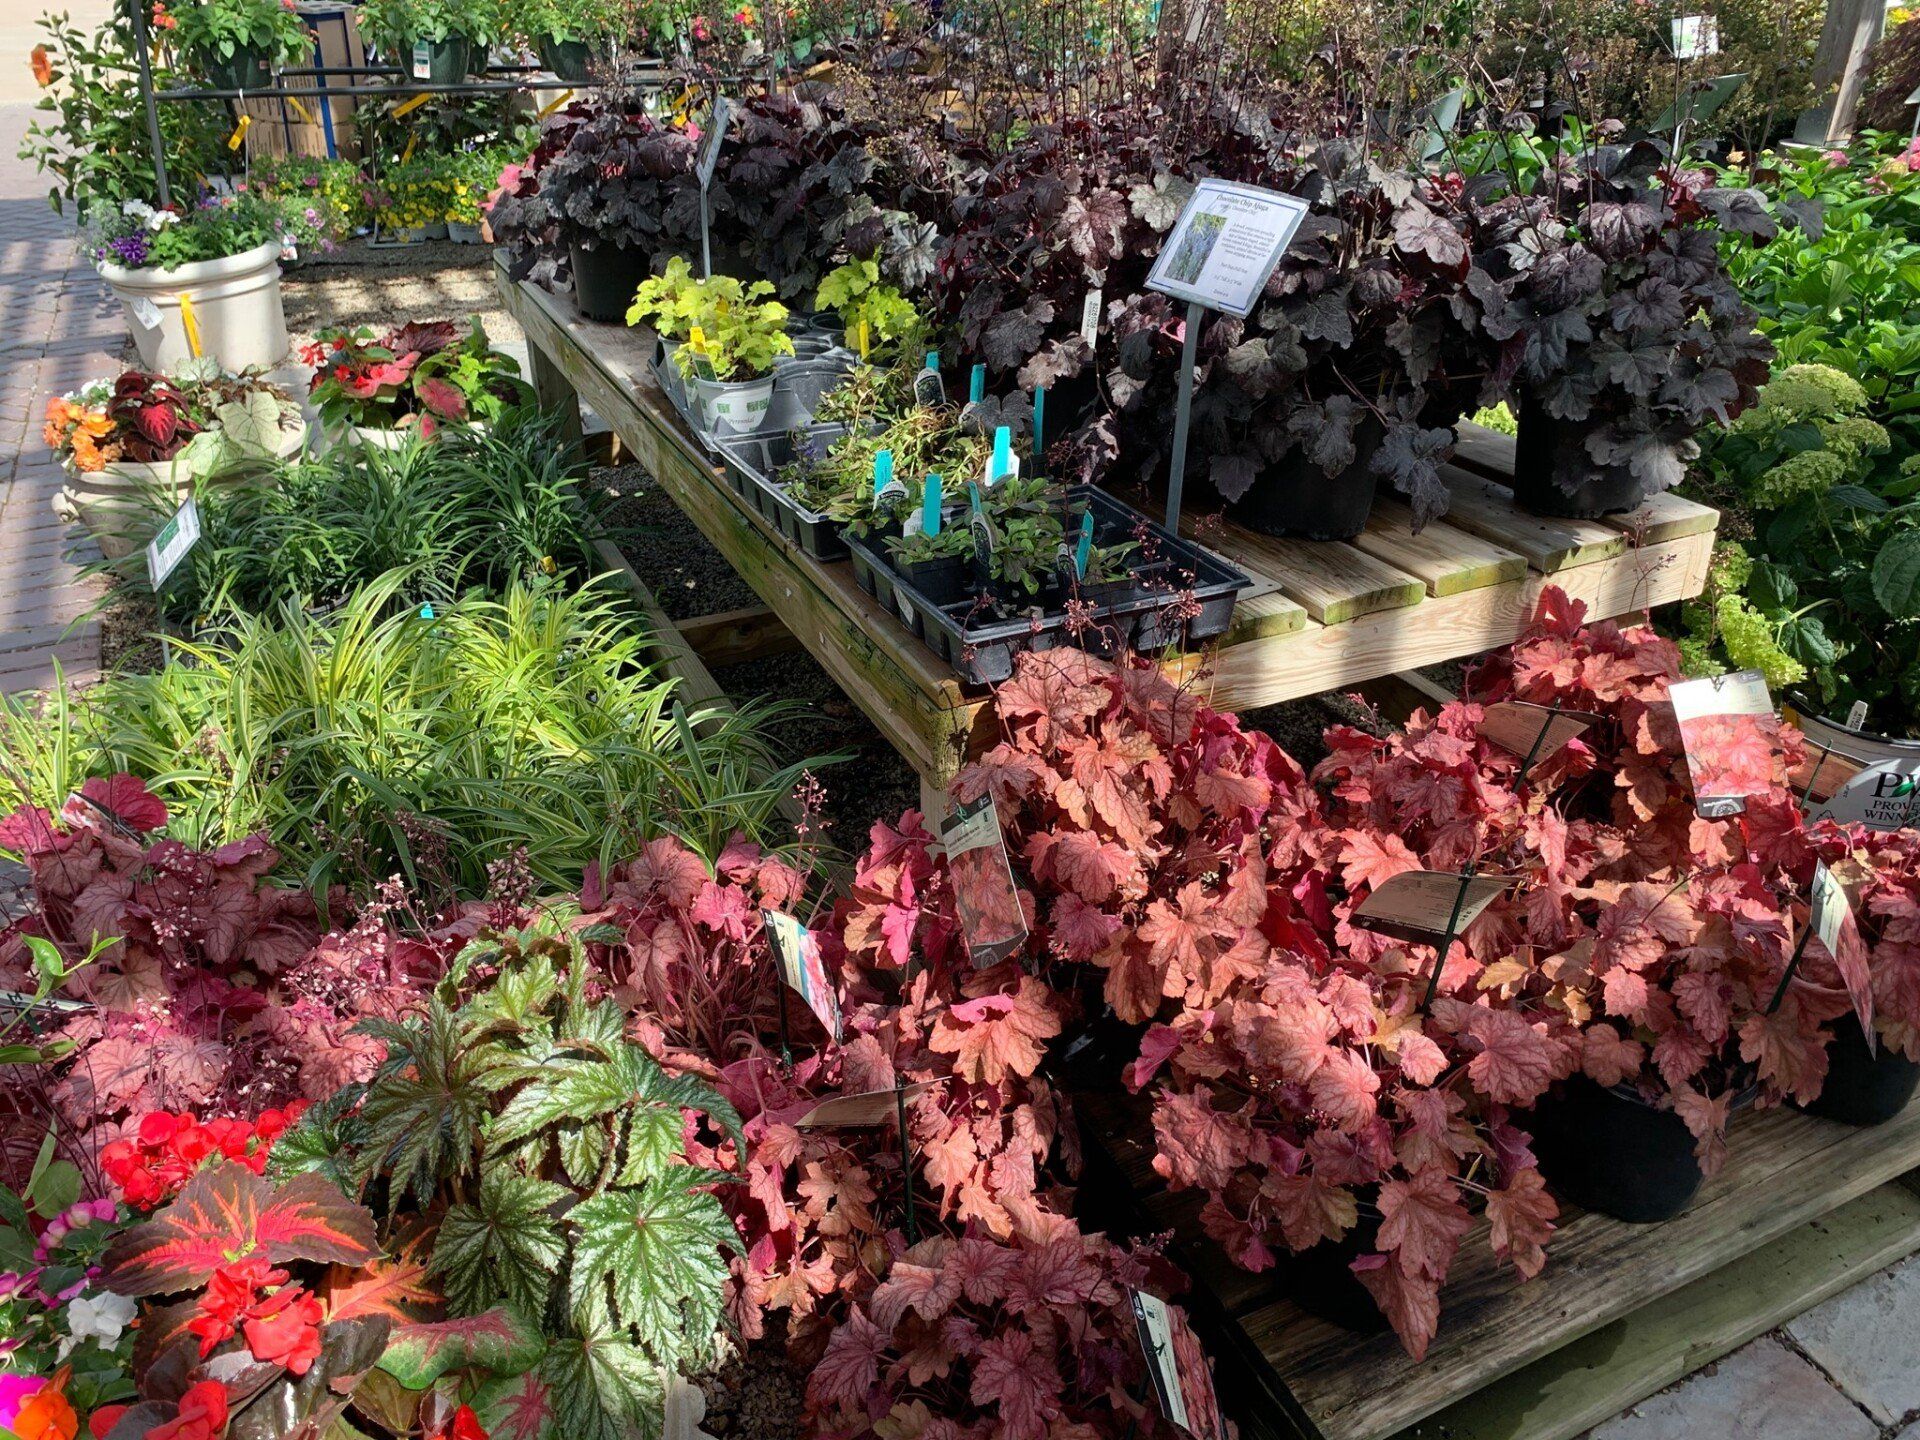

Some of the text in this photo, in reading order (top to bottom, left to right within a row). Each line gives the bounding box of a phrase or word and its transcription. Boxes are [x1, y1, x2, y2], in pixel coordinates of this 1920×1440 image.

[1216, 194, 1239, 204] Chocolate
[1240, 198, 1253, 208] Chip
[1864, 809, 1914, 822] WINN
